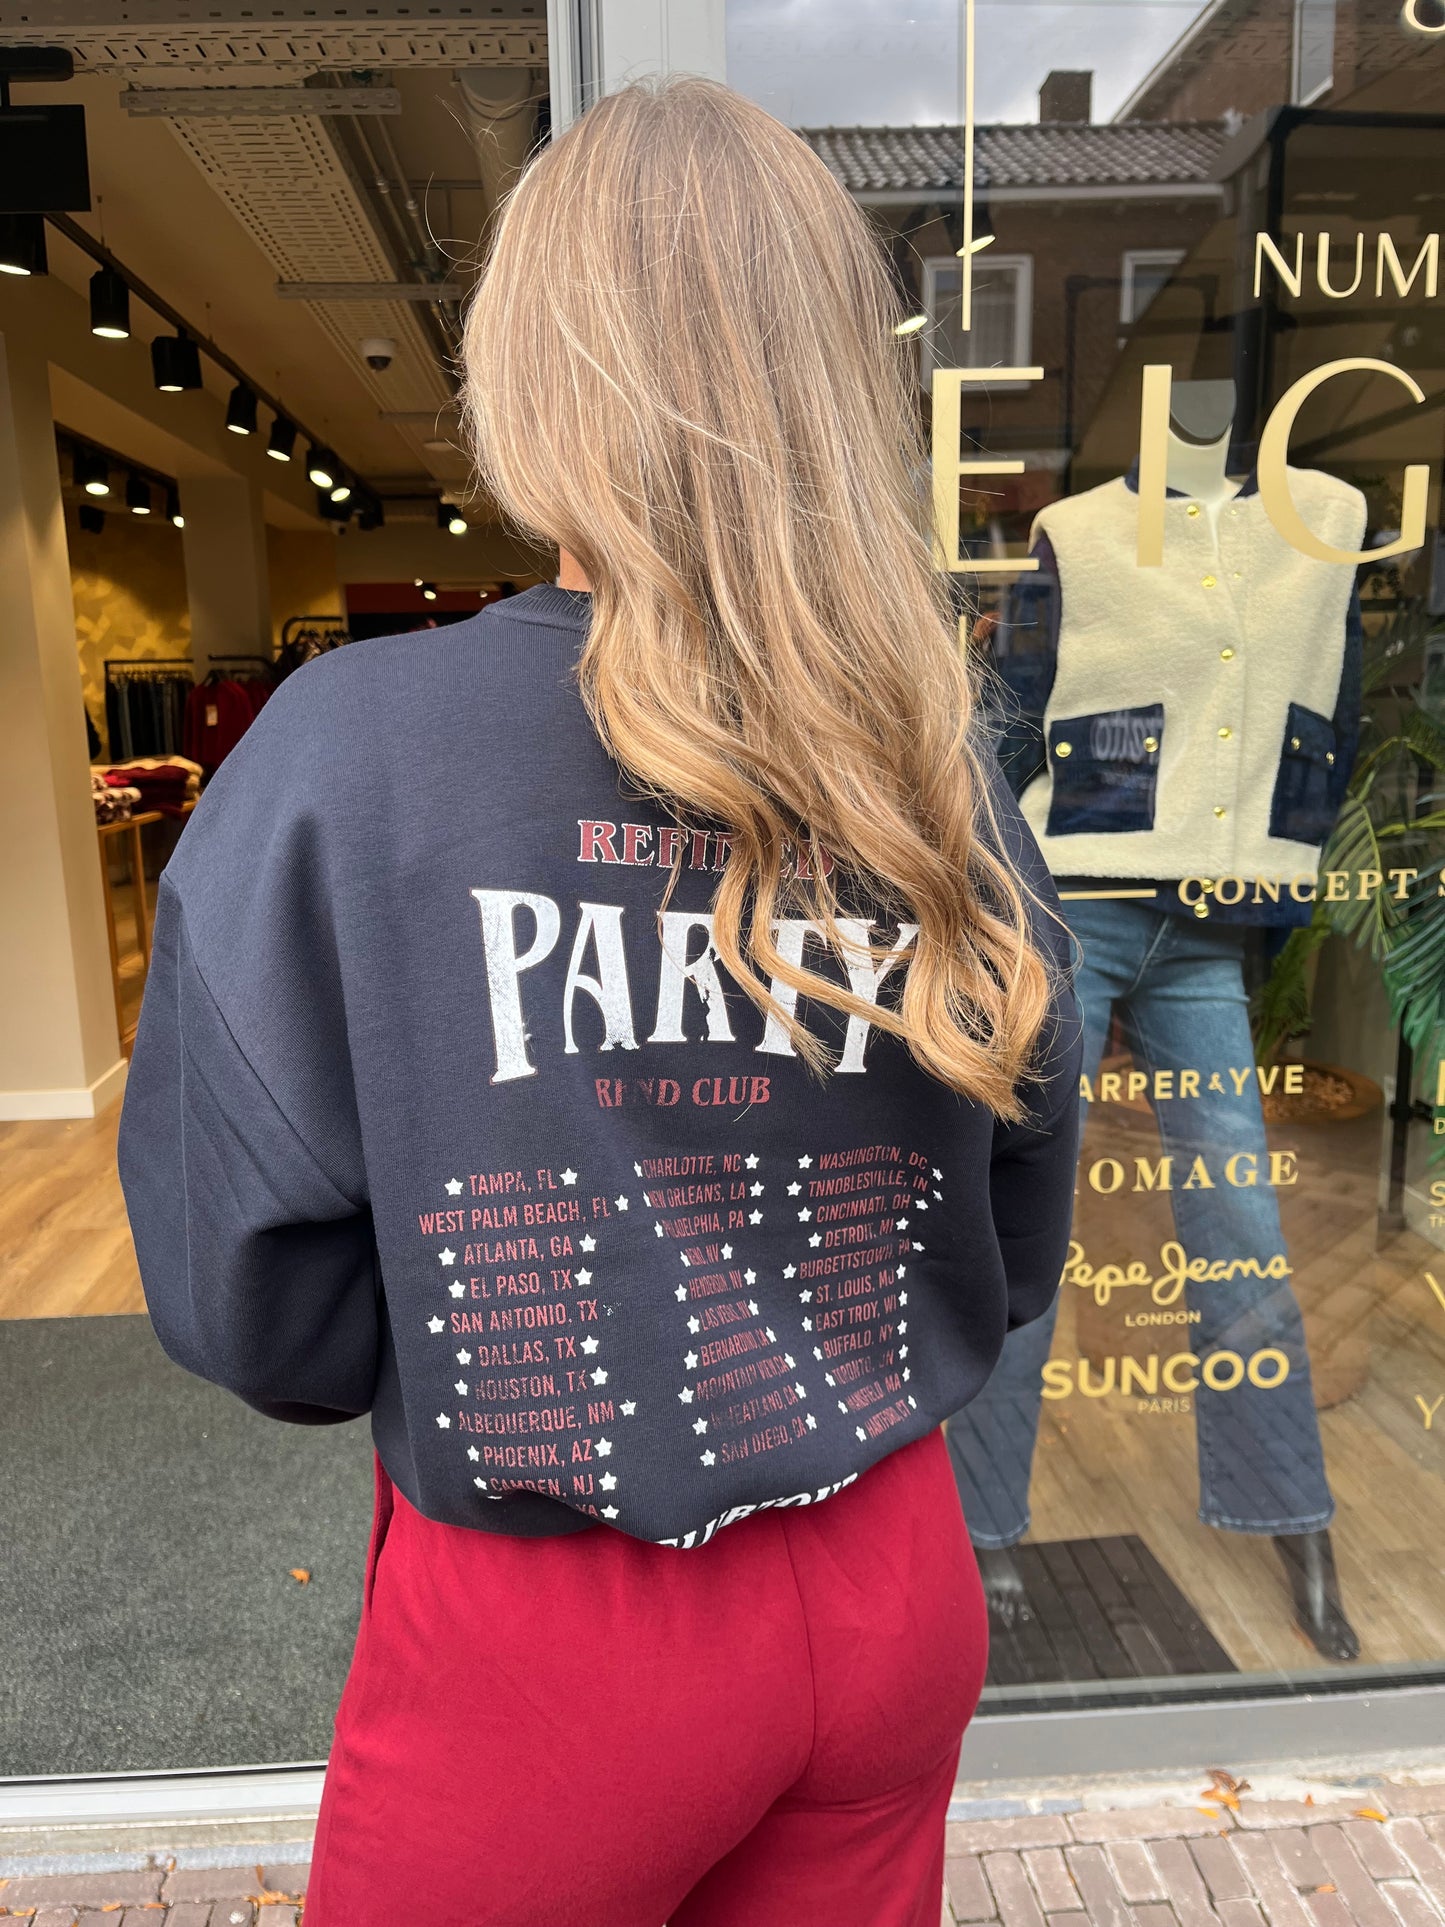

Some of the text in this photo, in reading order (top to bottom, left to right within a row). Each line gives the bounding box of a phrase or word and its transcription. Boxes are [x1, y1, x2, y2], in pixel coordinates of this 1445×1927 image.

[1178, 868, 1418, 907] CONCEPT
[468, 887, 920, 1085] PARTY
[691, 1075, 771, 1107] CLUB
[643, 1153, 742, 1179] CHARLOTTE, NC
[819, 1145, 928, 1171] WASHINGTON, DC
[1074, 1150, 1299, 1195] OMAGE
[469, 1169, 558, 1196] TAMPA, FL
[648, 1181, 746, 1208] NEW ORLEANS, LA
[912, 1175, 928, 1192] IN
[419, 1196, 611, 1235] WEST PALM BEACH, FL
[728, 1209, 745, 1230] PA
[816, 1193, 911, 1223] CINCINNATI, OH
[825, 1217, 894, 1249] DETROIT, MI
[464, 1235, 574, 1266] ATLANTA, GA
[705, 1242, 719, 1264] NV
[470, 1268, 573, 1300] EL PASO, TX
[728, 1268, 743, 1290] NV
[1151, 1240, 1294, 1307] Jeans
[816, 1284, 834, 1304] ST.
[837, 1274, 875, 1300] LOUIS,
[450, 1311, 484, 1335] SAN
[576, 1299, 599, 1322] TX
[698, 1307, 720, 1332] LAS
[815, 1293, 898, 1332] EAST TROY, WI
[1125, 1310, 1202, 1328] LONDON
[478, 1335, 577, 1367] DALLAS, TX
[755, 1327, 771, 1347] CA
[823, 1323, 894, 1359] BUFFALO, NY
[475, 1369, 588, 1401] HOUSTON, TX
[696, 1363, 758, 1401] MOUNTAIN
[773, 1354, 791, 1375] CA
[885, 1372, 902, 1394] MA
[1040, 1347, 1291, 1401] SUNCOO
[782, 1384, 799, 1406] CA
[1137, 1396, 1192, 1415] PARIS
[587, 1400, 615, 1425] NM
[483, 1438, 593, 1468] PHOENIX, AZ
[721, 1415, 808, 1463] SAN DIEGO, CA
[489, 1473, 595, 1498] CAMDEN, NJ
